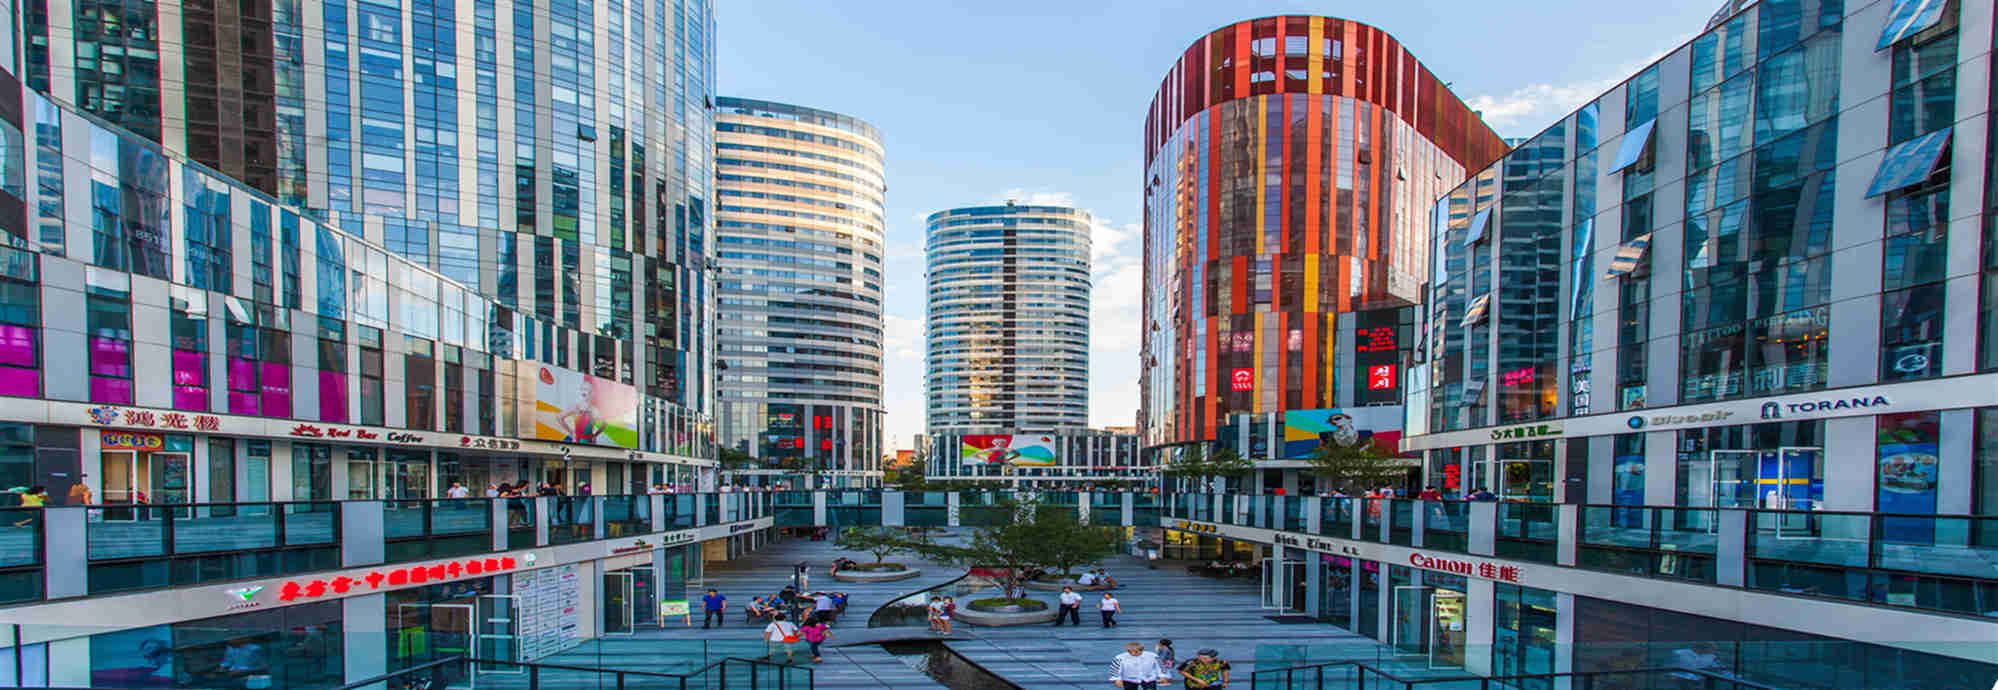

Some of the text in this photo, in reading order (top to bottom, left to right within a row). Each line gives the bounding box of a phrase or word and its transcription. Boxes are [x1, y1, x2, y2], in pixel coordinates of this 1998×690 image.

[1787, 395, 1890, 414] TORANA
[328, 428, 351, 438] Red
[357, 429, 377, 440] Bar
[388, 432, 424, 443] Coffee
[1409, 552, 1473, 576] Canon
[1478, 562, 1519, 583] 佳能
